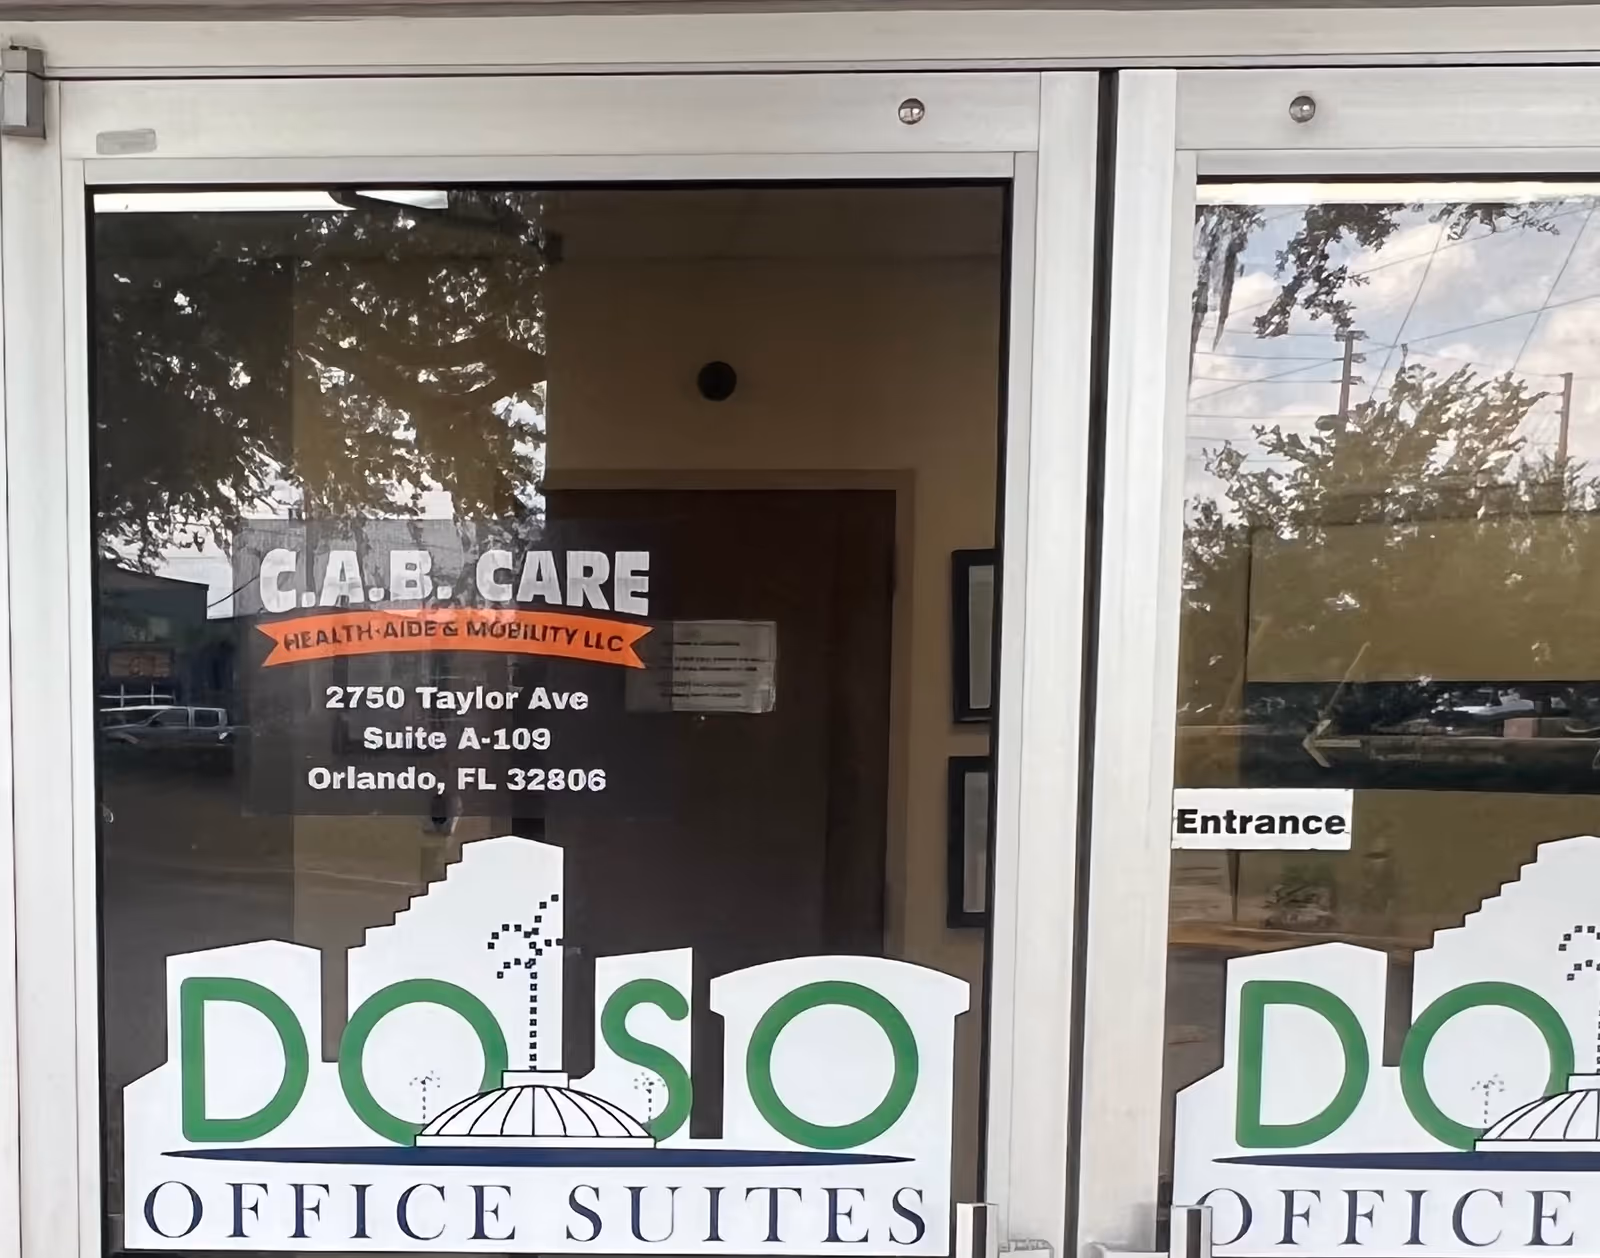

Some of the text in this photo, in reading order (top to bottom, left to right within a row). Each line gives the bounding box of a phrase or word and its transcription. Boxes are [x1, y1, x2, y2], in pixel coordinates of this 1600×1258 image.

[259, 548, 650, 617] C.A.B. CARE
[442, 620, 459, 637] &
[466, 620, 578, 646] MOBILITY
[583, 630, 624, 652] LLC
[325, 685, 590, 714] 2750 Taylor Ave
[363, 727, 552, 751] Suite A-109
[307, 766, 607, 795] Orlando, FL 32806
[1176, 808, 1346, 836] Entrance
[144, 1180, 926, 1246] OFFICE SUITES
[1194, 1187, 1576, 1248] OFFICE
